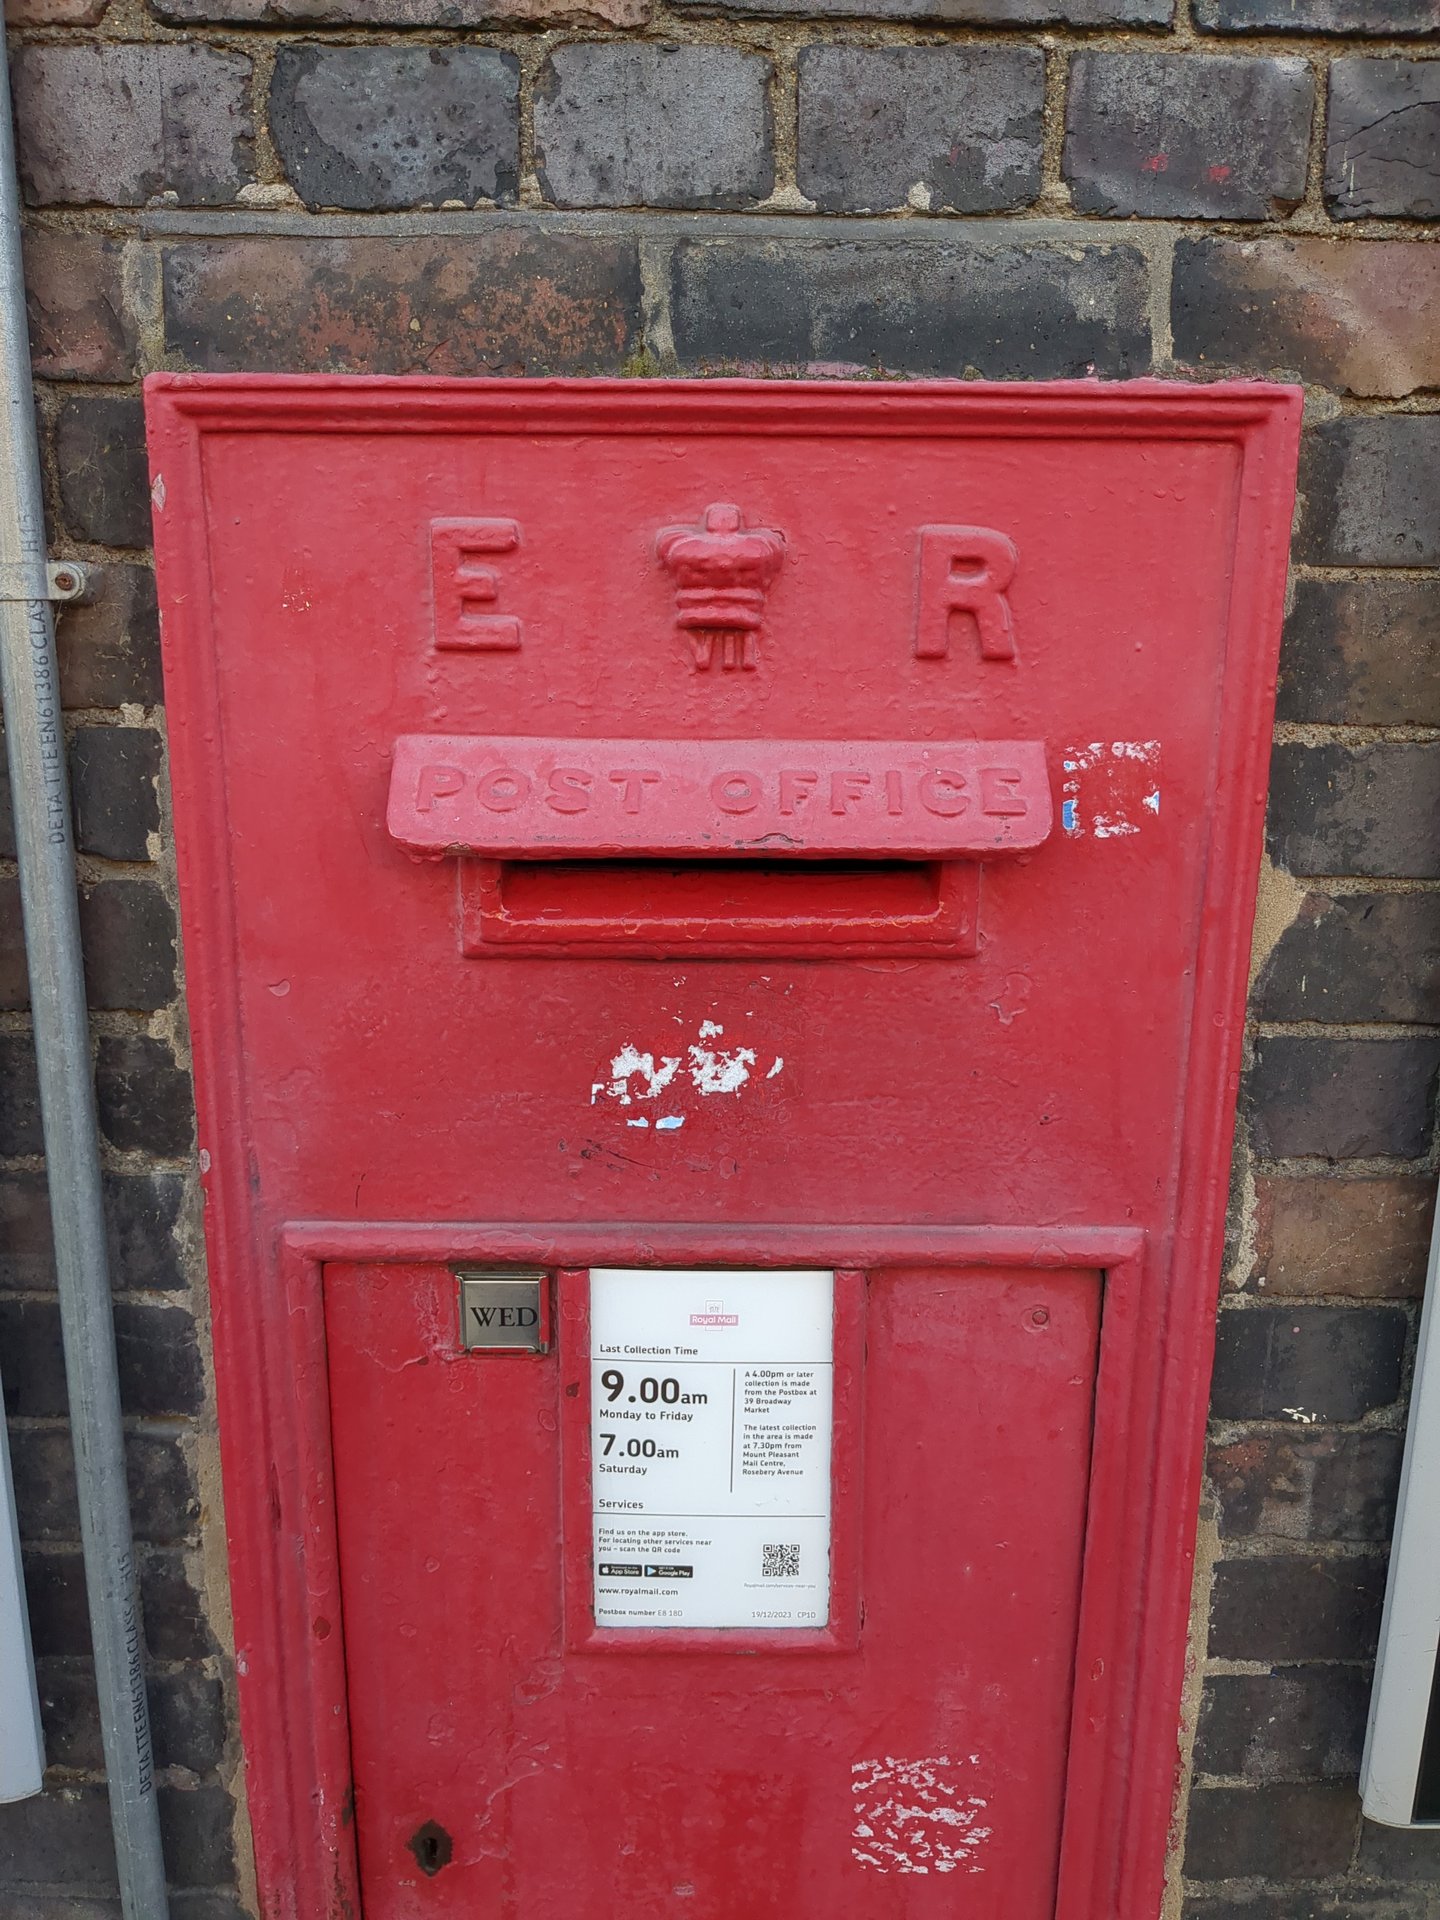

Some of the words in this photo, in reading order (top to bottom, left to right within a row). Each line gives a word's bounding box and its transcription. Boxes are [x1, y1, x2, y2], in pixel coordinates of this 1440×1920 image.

[428, 516, 522, 652] E
[914, 523, 1020, 661] R
[27, 599, 47, 649] CLAS
[42, 749, 60, 784] TTE
[415, 766, 660, 813] POST
[711, 768, 1029, 816] OFFICE
[47, 792, 65, 844] DETA
[470, 1307, 538, 1327] WED
[692, 1316, 716, 1324] Royal
[718, 1316, 737, 1324] Mail
[600, 1344, 621, 1353] Last
[624, 1345, 671, 1354] Collection
[674, 1346, 699, 1355] Time
[752, 1370, 784, 1379] 4.00pm
[601, 1369, 708, 1404] 9.00am
[756, 1398, 792, 1406] Broadway
[600, 1409, 642, 1421] Monday
[645, 1411, 656, 1420] to
[660, 1411, 694, 1422] Friday
[600, 1433, 679, 1458] 7.00am
[753, 1442, 782, 1451] 7.30pm
[599, 1464, 648, 1475] Saturday
[598, 1499, 644, 1509] Services
[652, 1530, 666, 1538] app
[612, 1537, 641, 1545] locating
[598, 1588, 678, 1596] www.royalmail.com
